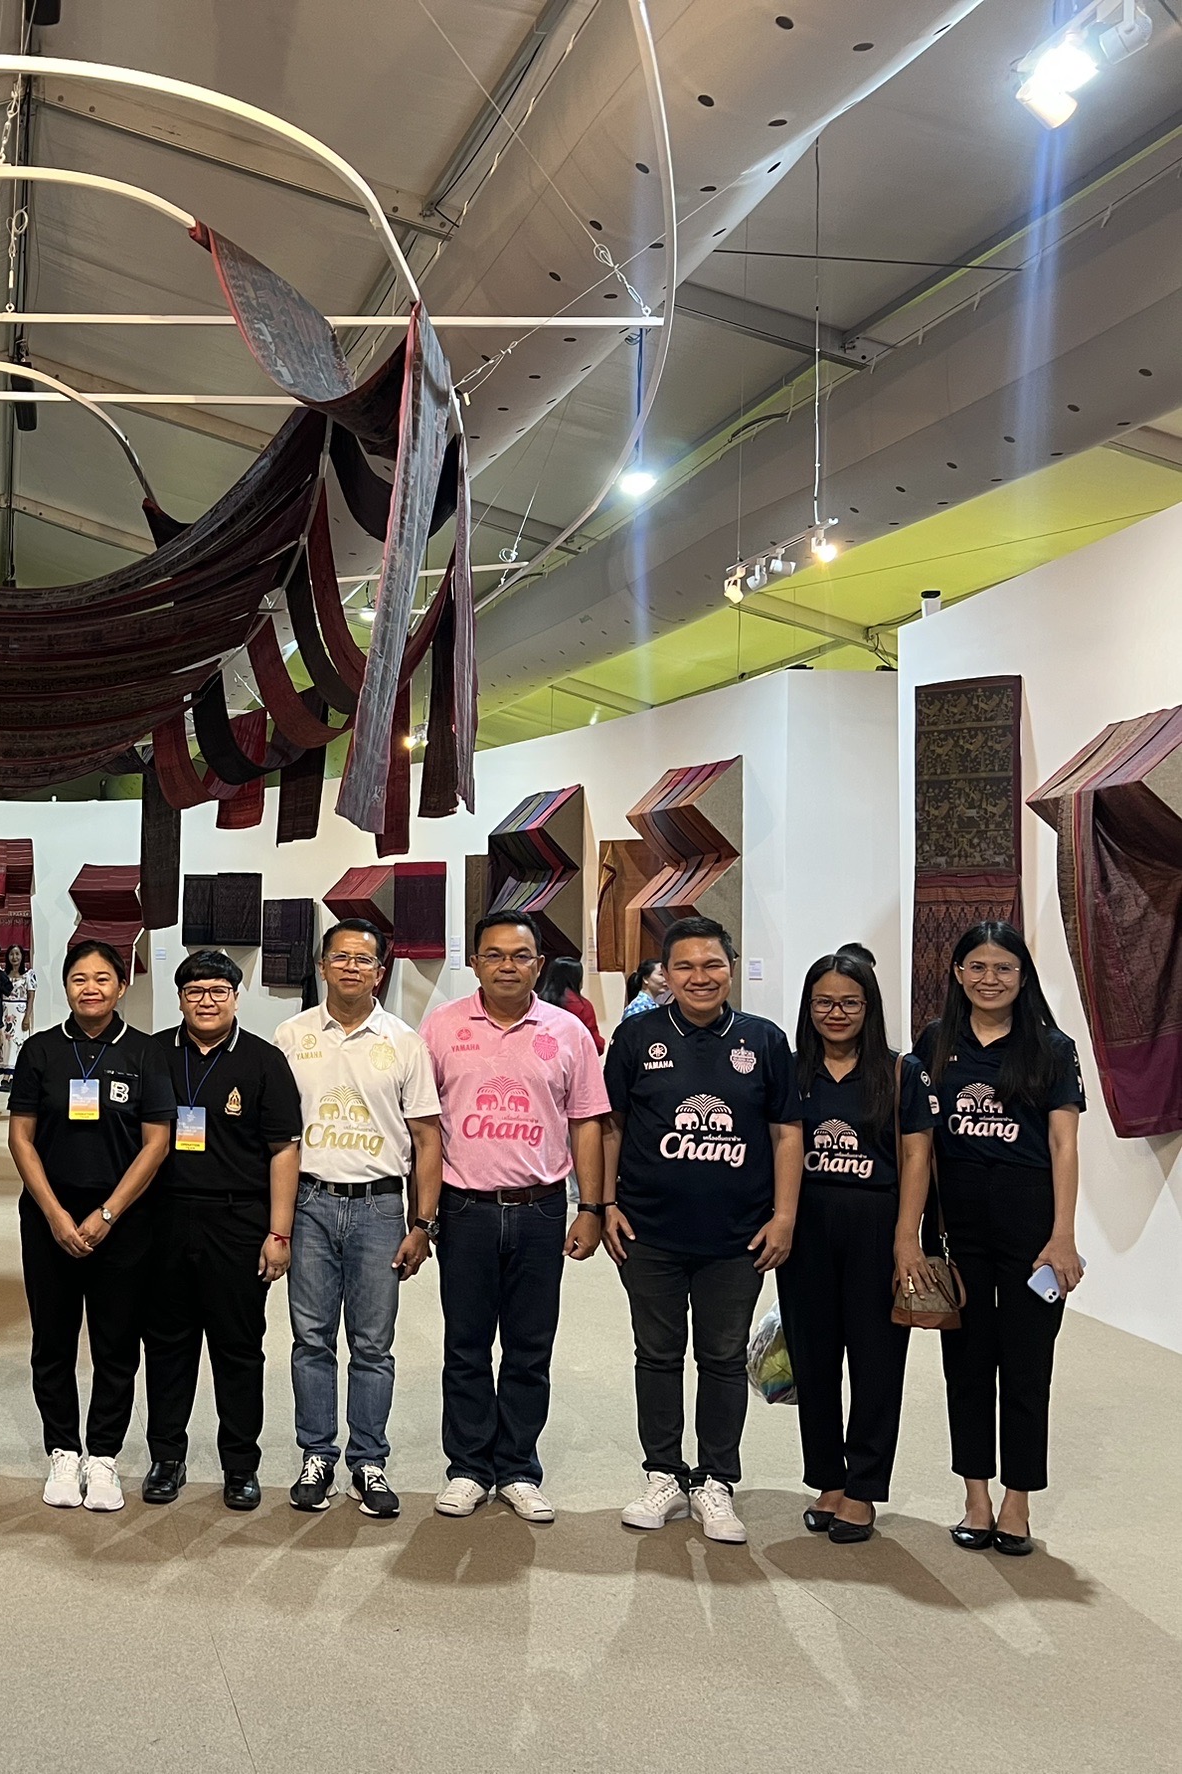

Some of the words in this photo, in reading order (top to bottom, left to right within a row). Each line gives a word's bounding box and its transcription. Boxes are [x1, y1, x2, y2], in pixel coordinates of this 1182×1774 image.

[296, 1051, 323, 1060] YAMAHA
[451, 1044, 480, 1053] YAMAHA
[643, 1060, 674, 1070] YAMAHA
[304, 1123, 385, 1158] Chang
[462, 1113, 544, 1147] Chang
[948, 1114, 1020, 1143] Chang
[659, 1132, 747, 1168] Chang
[803, 1150, 874, 1180] Chang
